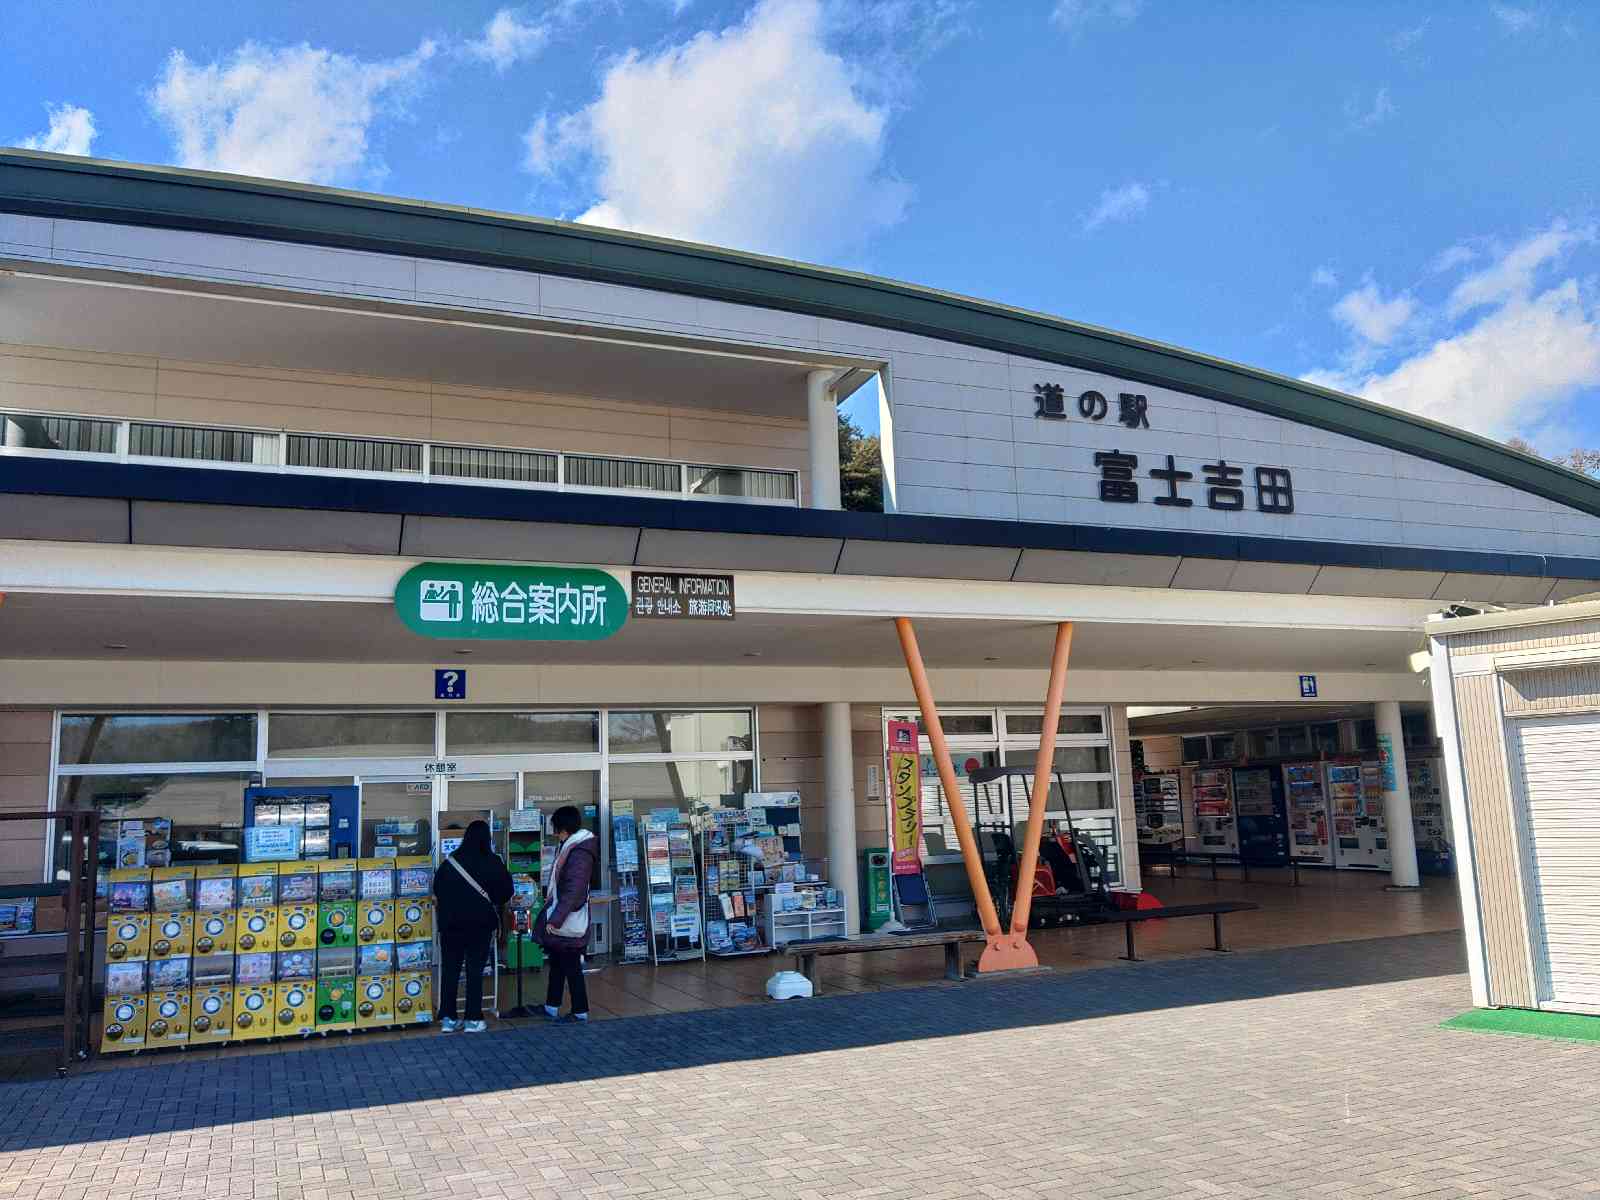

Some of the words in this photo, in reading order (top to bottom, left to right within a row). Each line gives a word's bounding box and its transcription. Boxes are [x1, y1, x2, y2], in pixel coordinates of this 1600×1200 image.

[1032, 382, 1150, 428] 道の駅
[1093, 449, 1295, 514] 富士吉田
[471, 580, 608, 627] 総合案内所
[637, 576, 675, 594] GENERAL
[679, 577, 729, 596] INFORMATION
